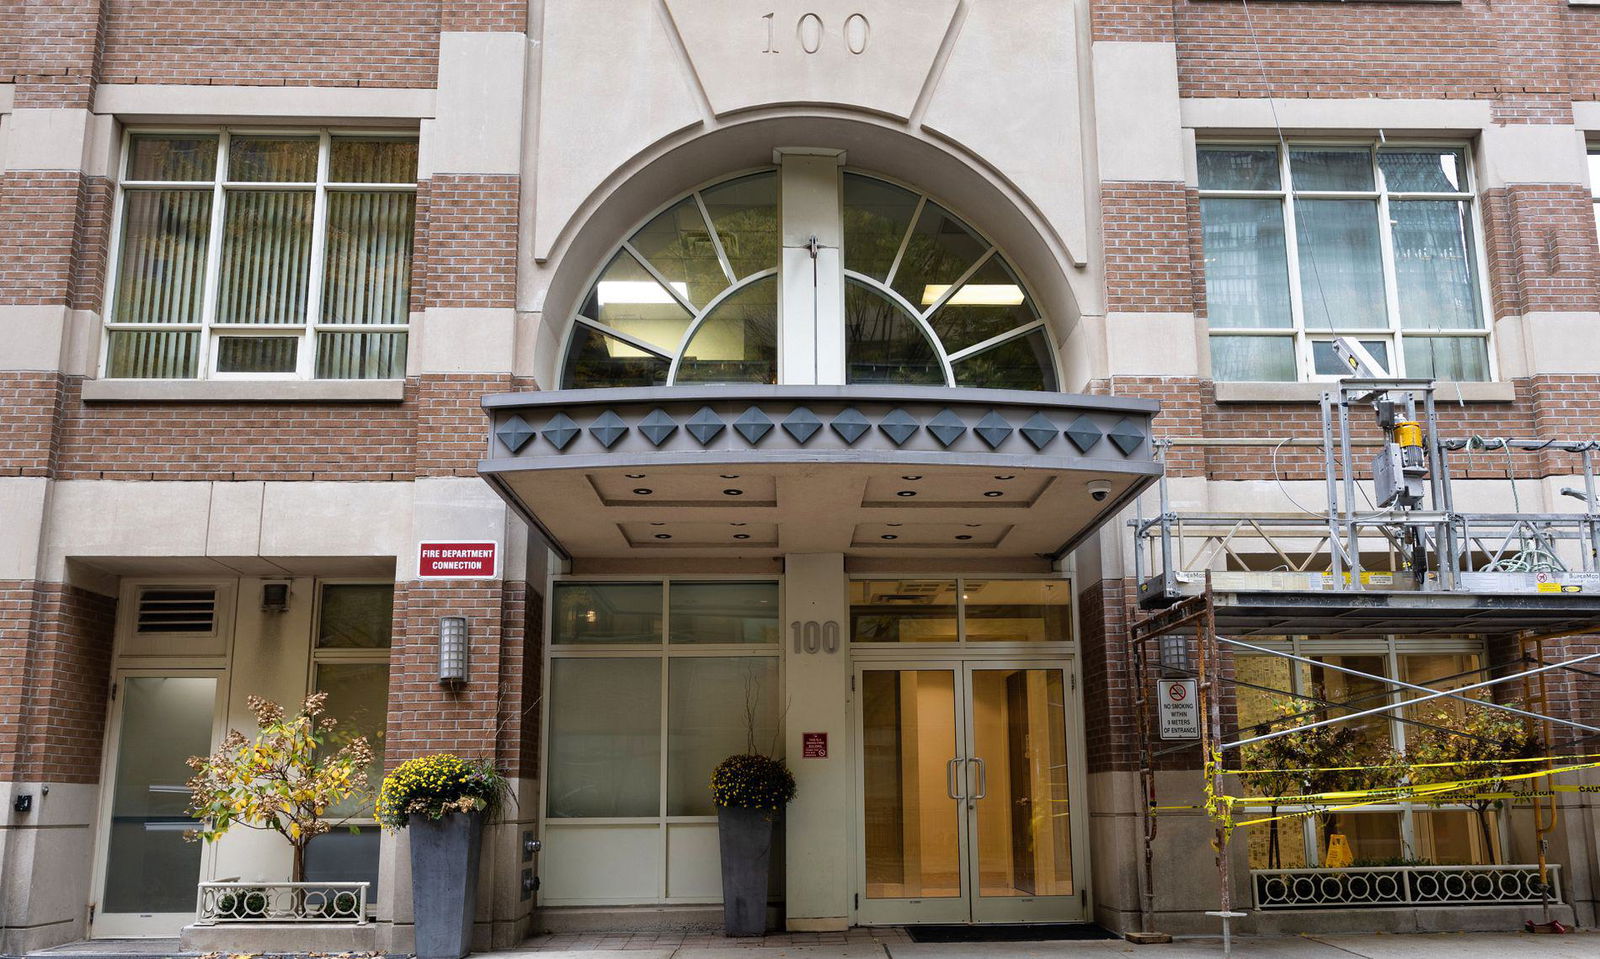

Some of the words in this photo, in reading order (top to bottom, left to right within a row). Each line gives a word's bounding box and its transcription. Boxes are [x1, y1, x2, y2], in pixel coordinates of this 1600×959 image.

[761, 12, 870, 55] 100
[422, 549, 440, 558] FIRE
[442, 549, 493, 558] DEPARTMENT
[432, 561, 482, 570] CONNECTION
[791, 621, 840, 654] 100
